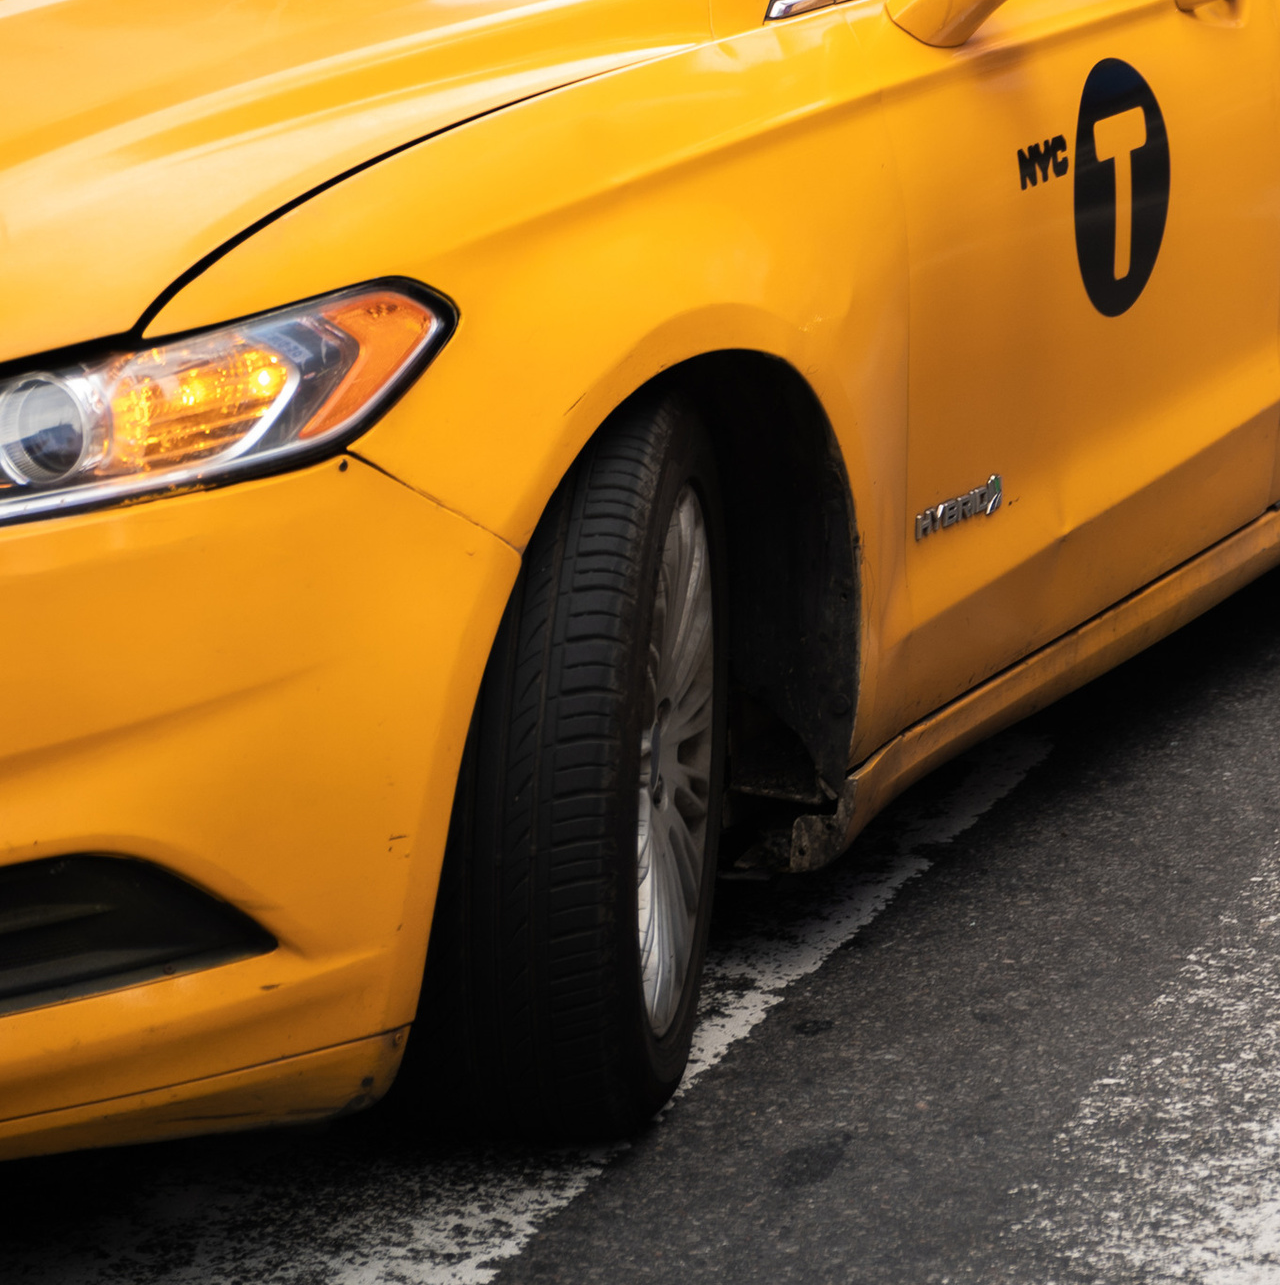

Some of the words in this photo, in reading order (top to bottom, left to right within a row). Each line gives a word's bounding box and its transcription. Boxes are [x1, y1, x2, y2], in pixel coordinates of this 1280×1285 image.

[1017, 133, 1069, 191] NYC
[1093, 105, 1147, 281] T
[915, 486, 988, 542] HYBRID
